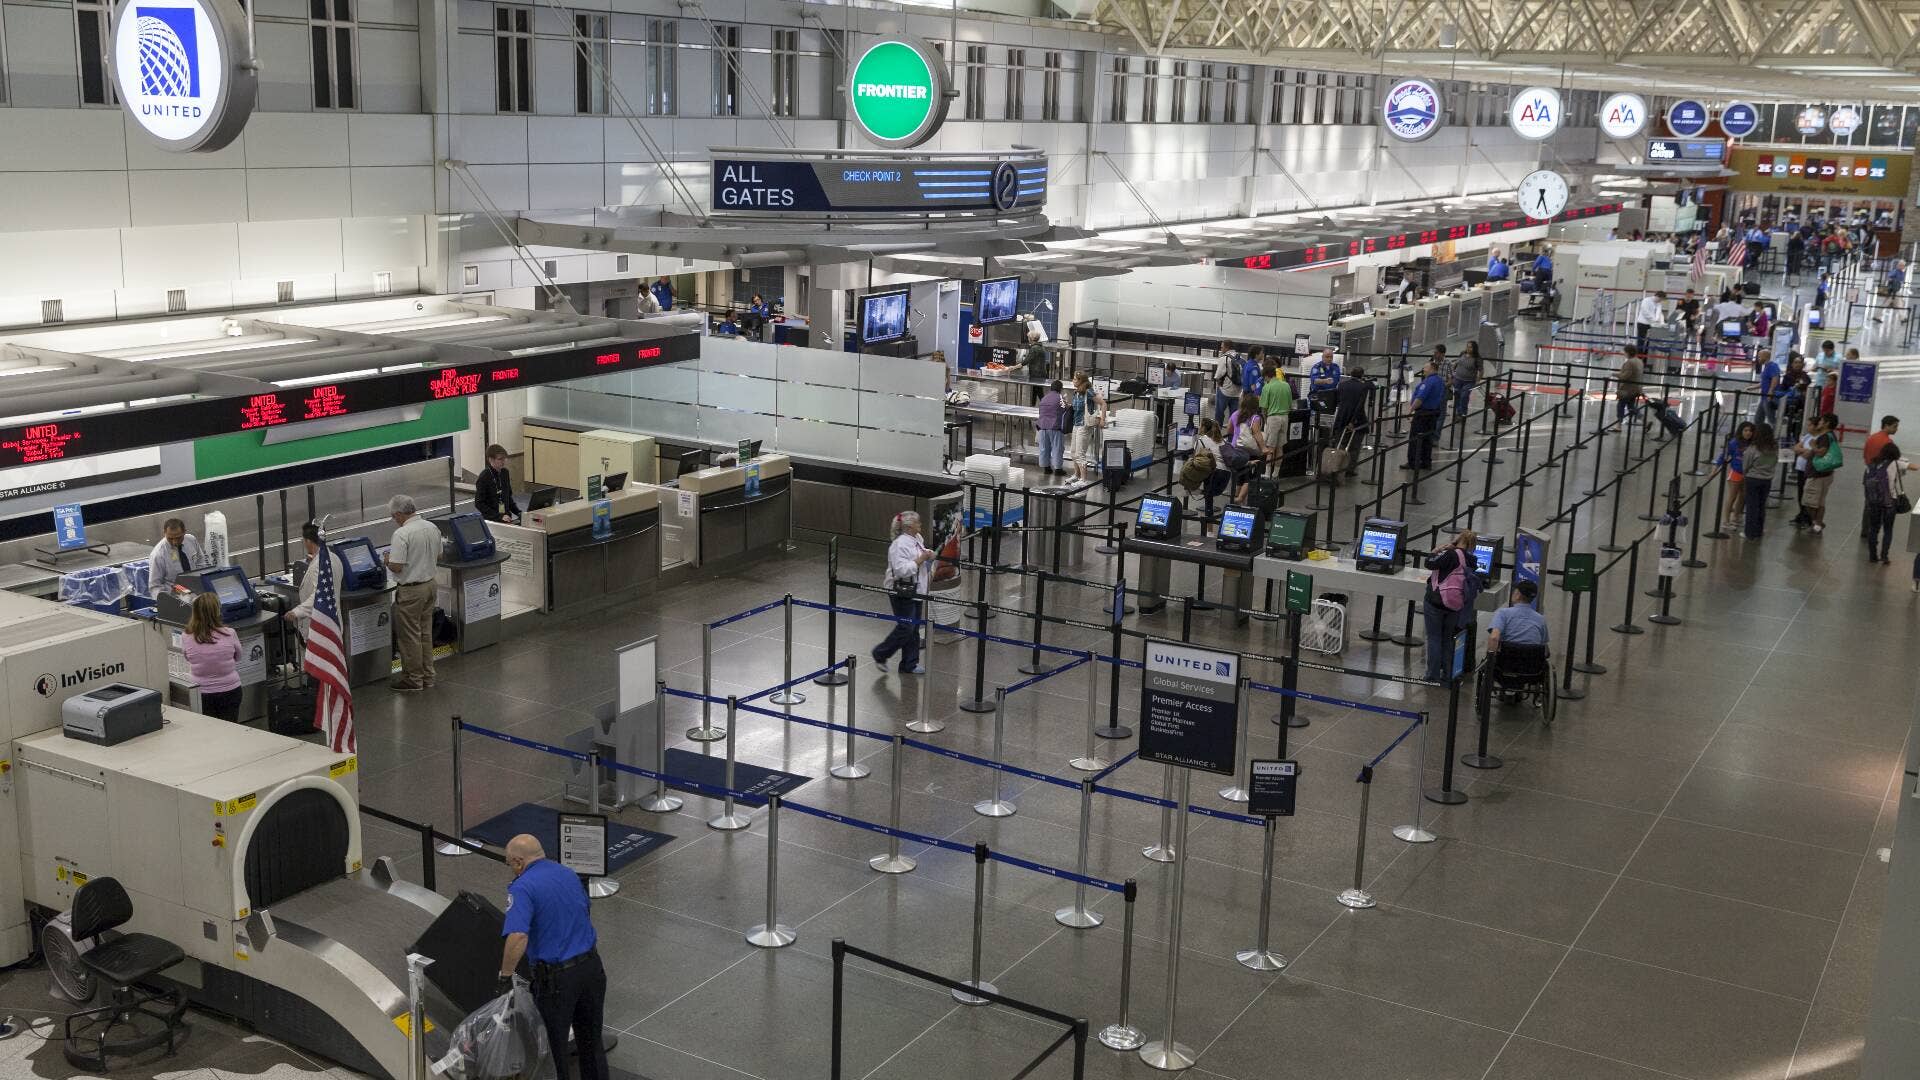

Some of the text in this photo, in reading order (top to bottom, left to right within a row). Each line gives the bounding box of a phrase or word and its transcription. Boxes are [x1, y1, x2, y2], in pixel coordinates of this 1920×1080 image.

[857, 83, 927, 99] FRONTIER
[142, 104, 202, 118] UNITED
[1651, 142, 1666, 151] ALL
[722, 166, 763, 183] ALL
[843, 170, 901, 182] CHECK POINT 2
[1000, 171, 1015, 202] 2
[722, 187, 794, 206] GATES
[597, 353, 621, 365] FRONTIER
[638, 347, 661, 359] FRONTIER
[492, 368, 519, 380] FRONTIER
[312, 386, 337, 398] UNITED
[461, 383, 478, 394] PLUS
[250, 394, 276, 407] UNITED
[25, 424, 58, 440] UNITED
[0, 483, 58, 499] STAR ALLIANCE
[1143, 498, 1172, 507] FRONTIER
[1224, 510, 1255, 520] FRONTIER
[1364, 529, 1397, 539] FRONTIER
[1155, 653, 1212, 672] UNITED
[61, 662, 125, 688] InVision
[1153, 676, 1215, 695] Global Services
[1152, 694, 1213, 713] Premier Access
[1151, 706, 1172, 716] Premier
[1151, 712, 1172, 722] Premier
[1150, 719, 1180, 730] Global First
[1155, 752, 1209, 768] STAR ALLIANCE
